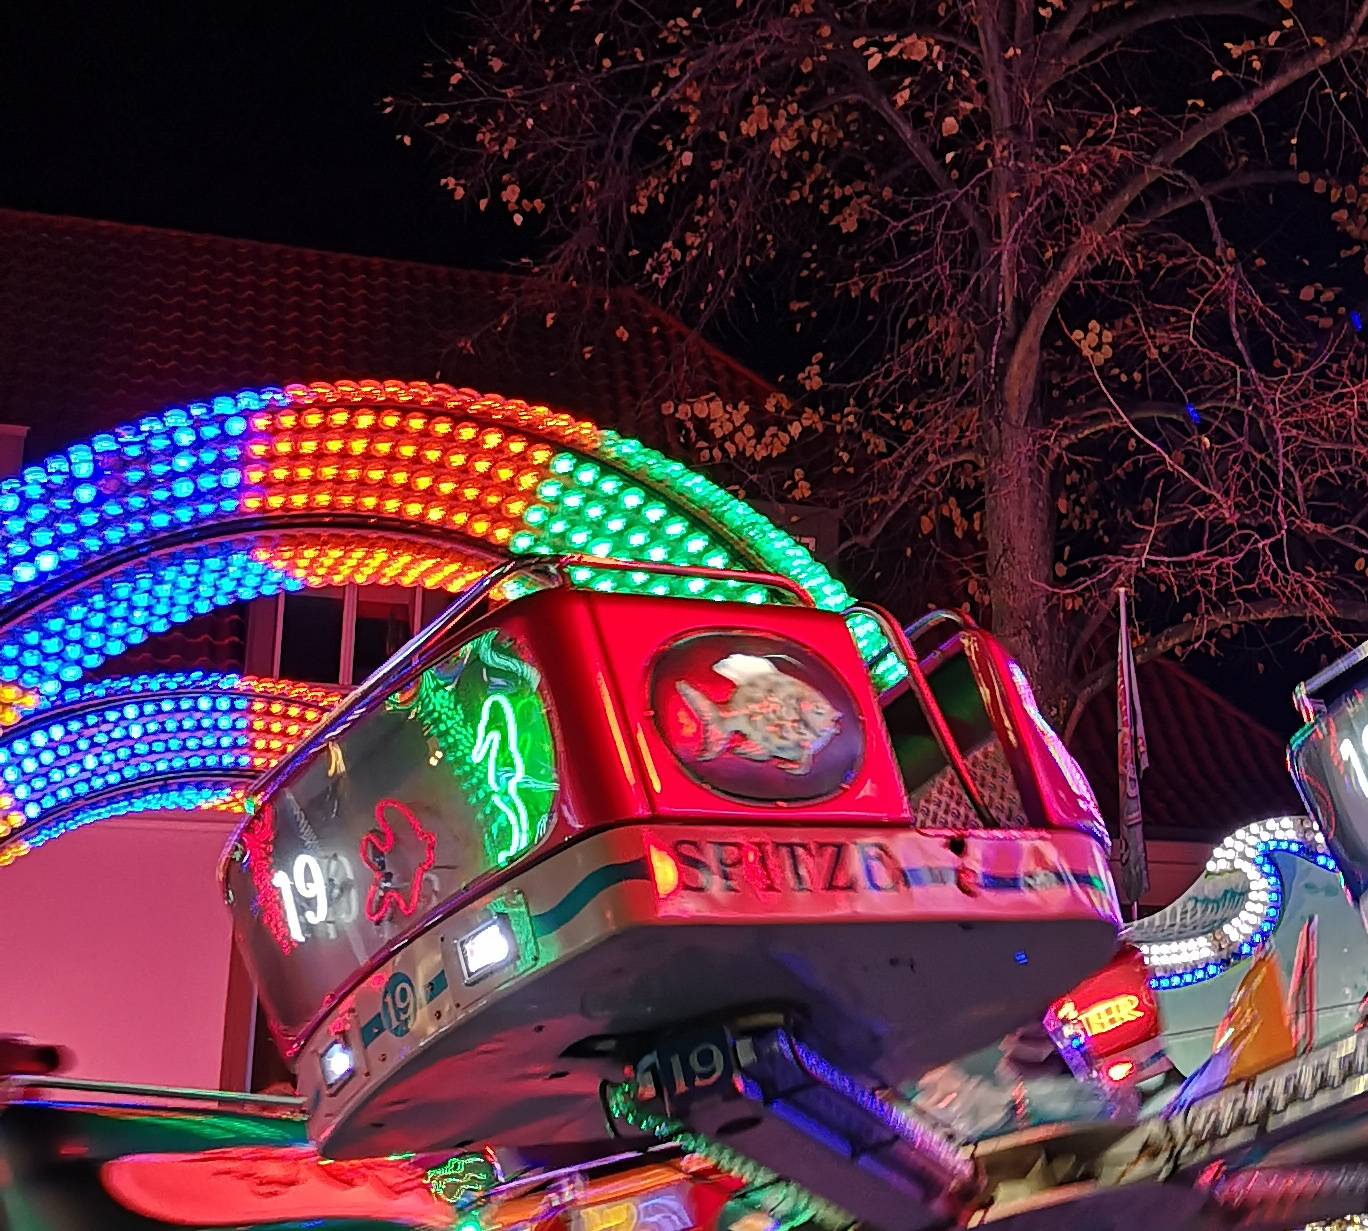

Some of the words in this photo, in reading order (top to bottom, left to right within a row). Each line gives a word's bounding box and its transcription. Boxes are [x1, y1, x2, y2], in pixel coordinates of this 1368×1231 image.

[273, 854, 328, 942] 19
[383, 981, 417, 1034] 19
[669, 1043, 724, 1096] 19
